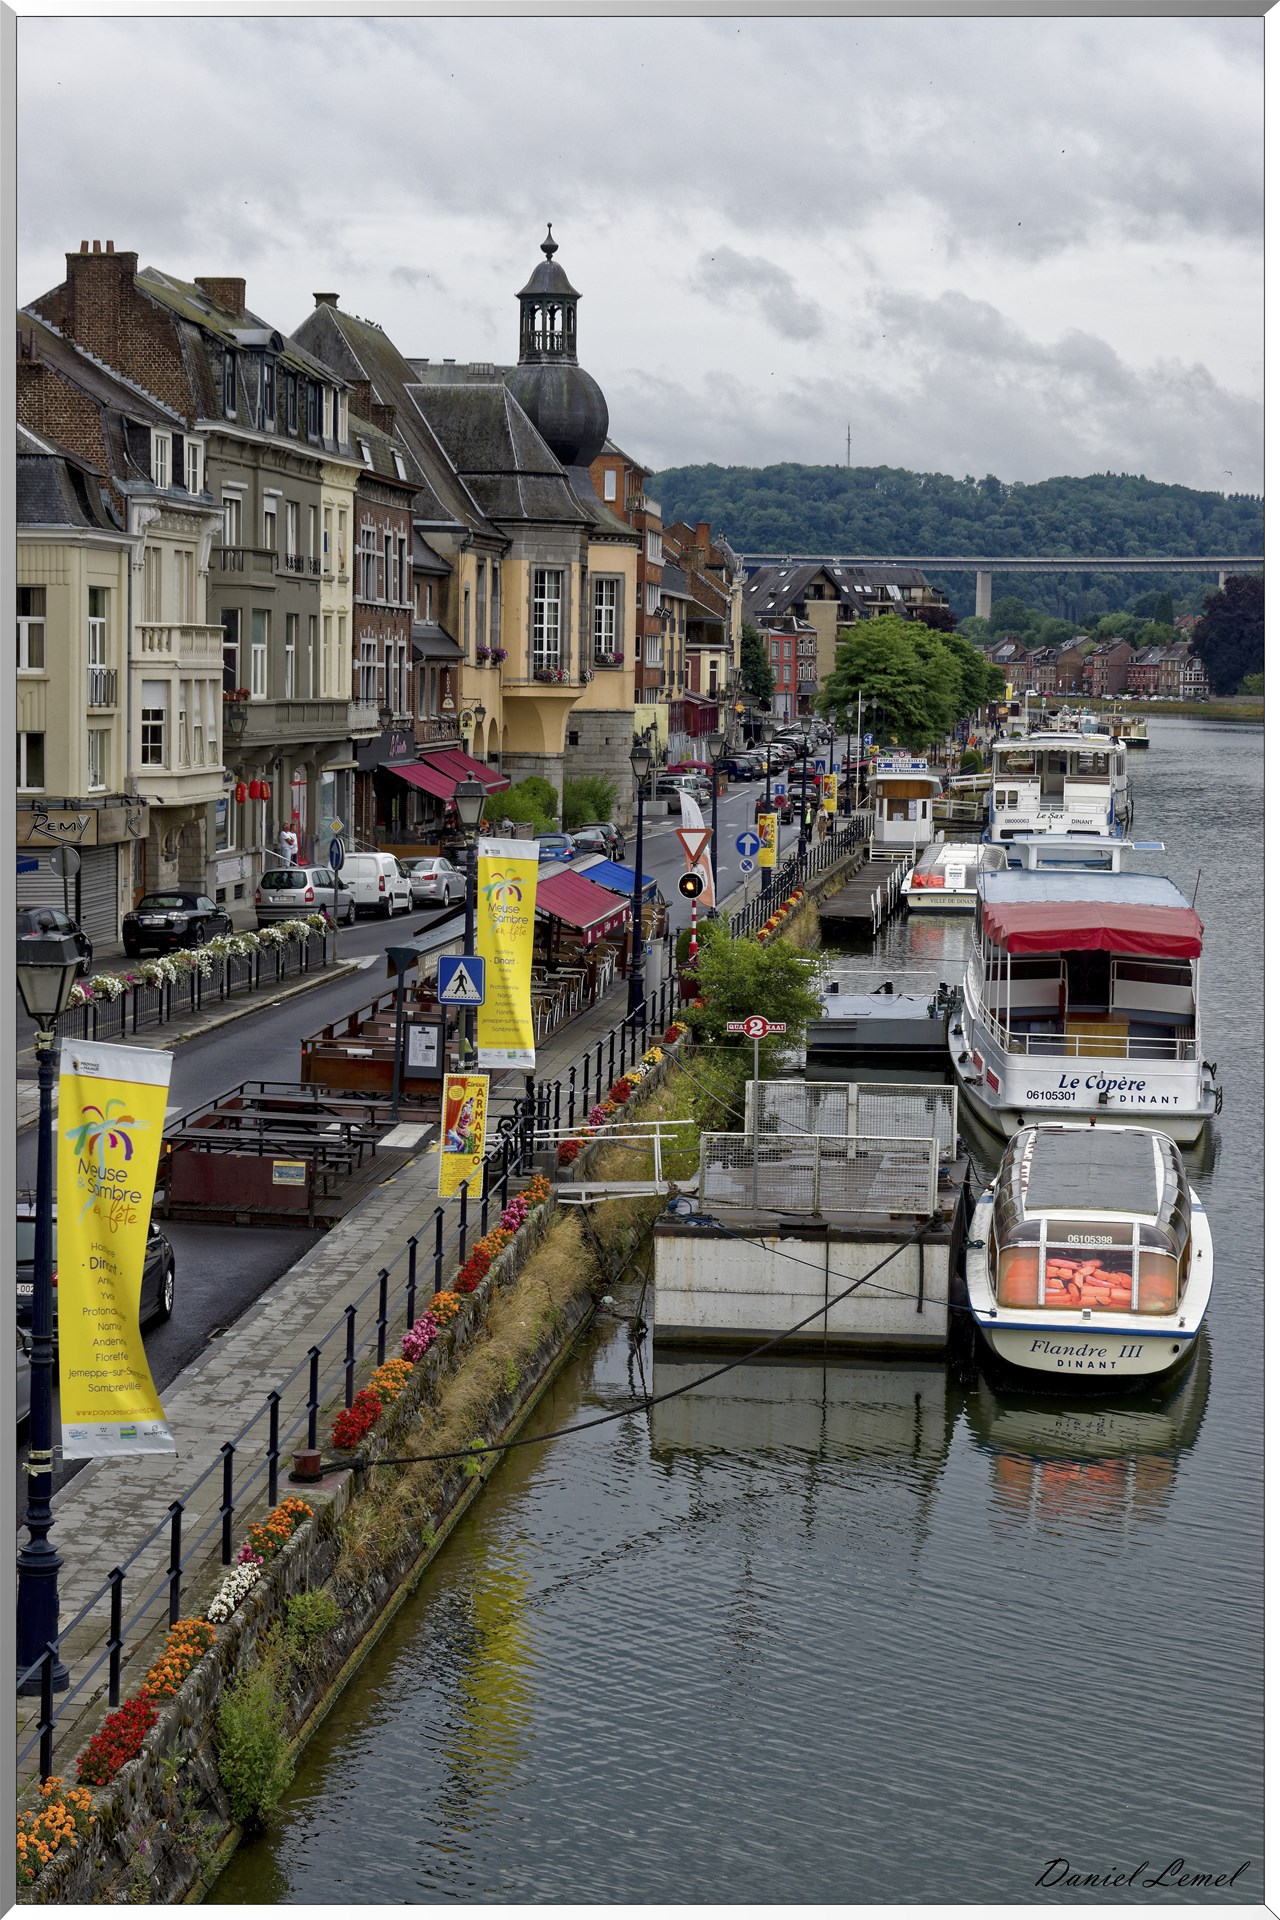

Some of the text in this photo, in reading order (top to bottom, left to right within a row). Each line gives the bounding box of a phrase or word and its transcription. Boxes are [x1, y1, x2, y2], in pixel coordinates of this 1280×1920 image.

[1047, 812, 1065, 820] Sax
[488, 903, 520, 914] Meuse
[493, 914, 529, 925] Sambre
[494, 956, 515, 965] Dinant
[749, 1019, 763, 1036] 2
[1058, 1074, 1146, 1093] Le Copère
[1026, 1090, 1076, 1101] 06105301
[1119, 1095, 1179, 1104] DINANT
[472, 1088, 484, 1166] ARMANZO
[88, 1177, 142, 1204] Sambre
[1067, 1234, 1113, 1244] 06105398
[1029, 1339, 1144, 1358] Flandre III
[95, 1351, 129, 1362] Floreffe
[1057, 1359, 1116, 1369] DINANT
[88, 1382, 141, 1393] Sambreville
